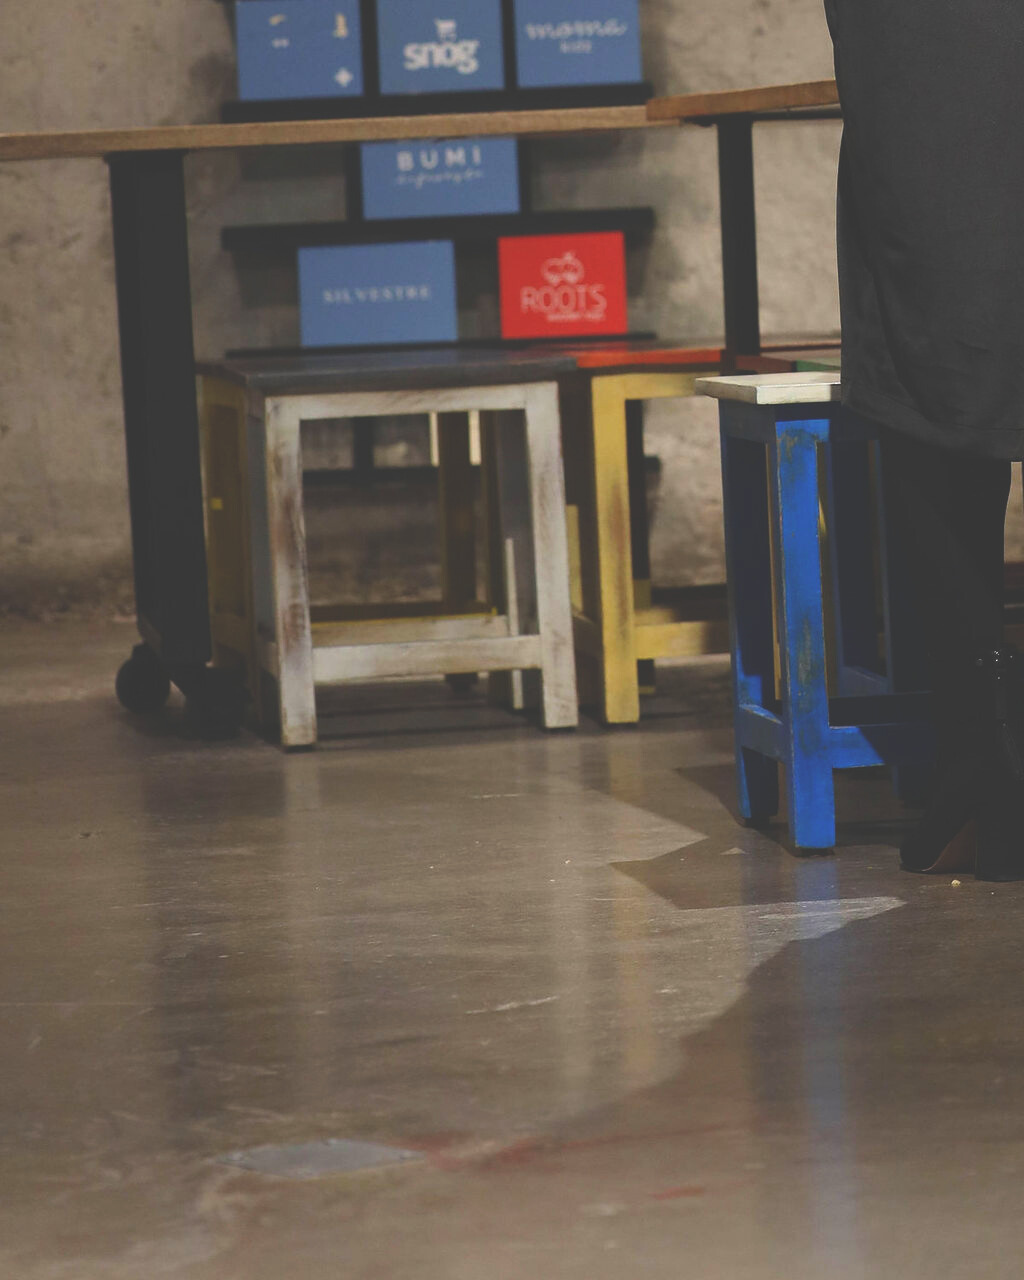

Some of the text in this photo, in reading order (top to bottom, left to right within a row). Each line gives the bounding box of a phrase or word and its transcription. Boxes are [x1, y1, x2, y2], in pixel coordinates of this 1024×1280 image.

[403, 39, 480, 75] snog
[396, 145, 482, 172] BUMI
[520, 282, 608, 315] ROOTS
